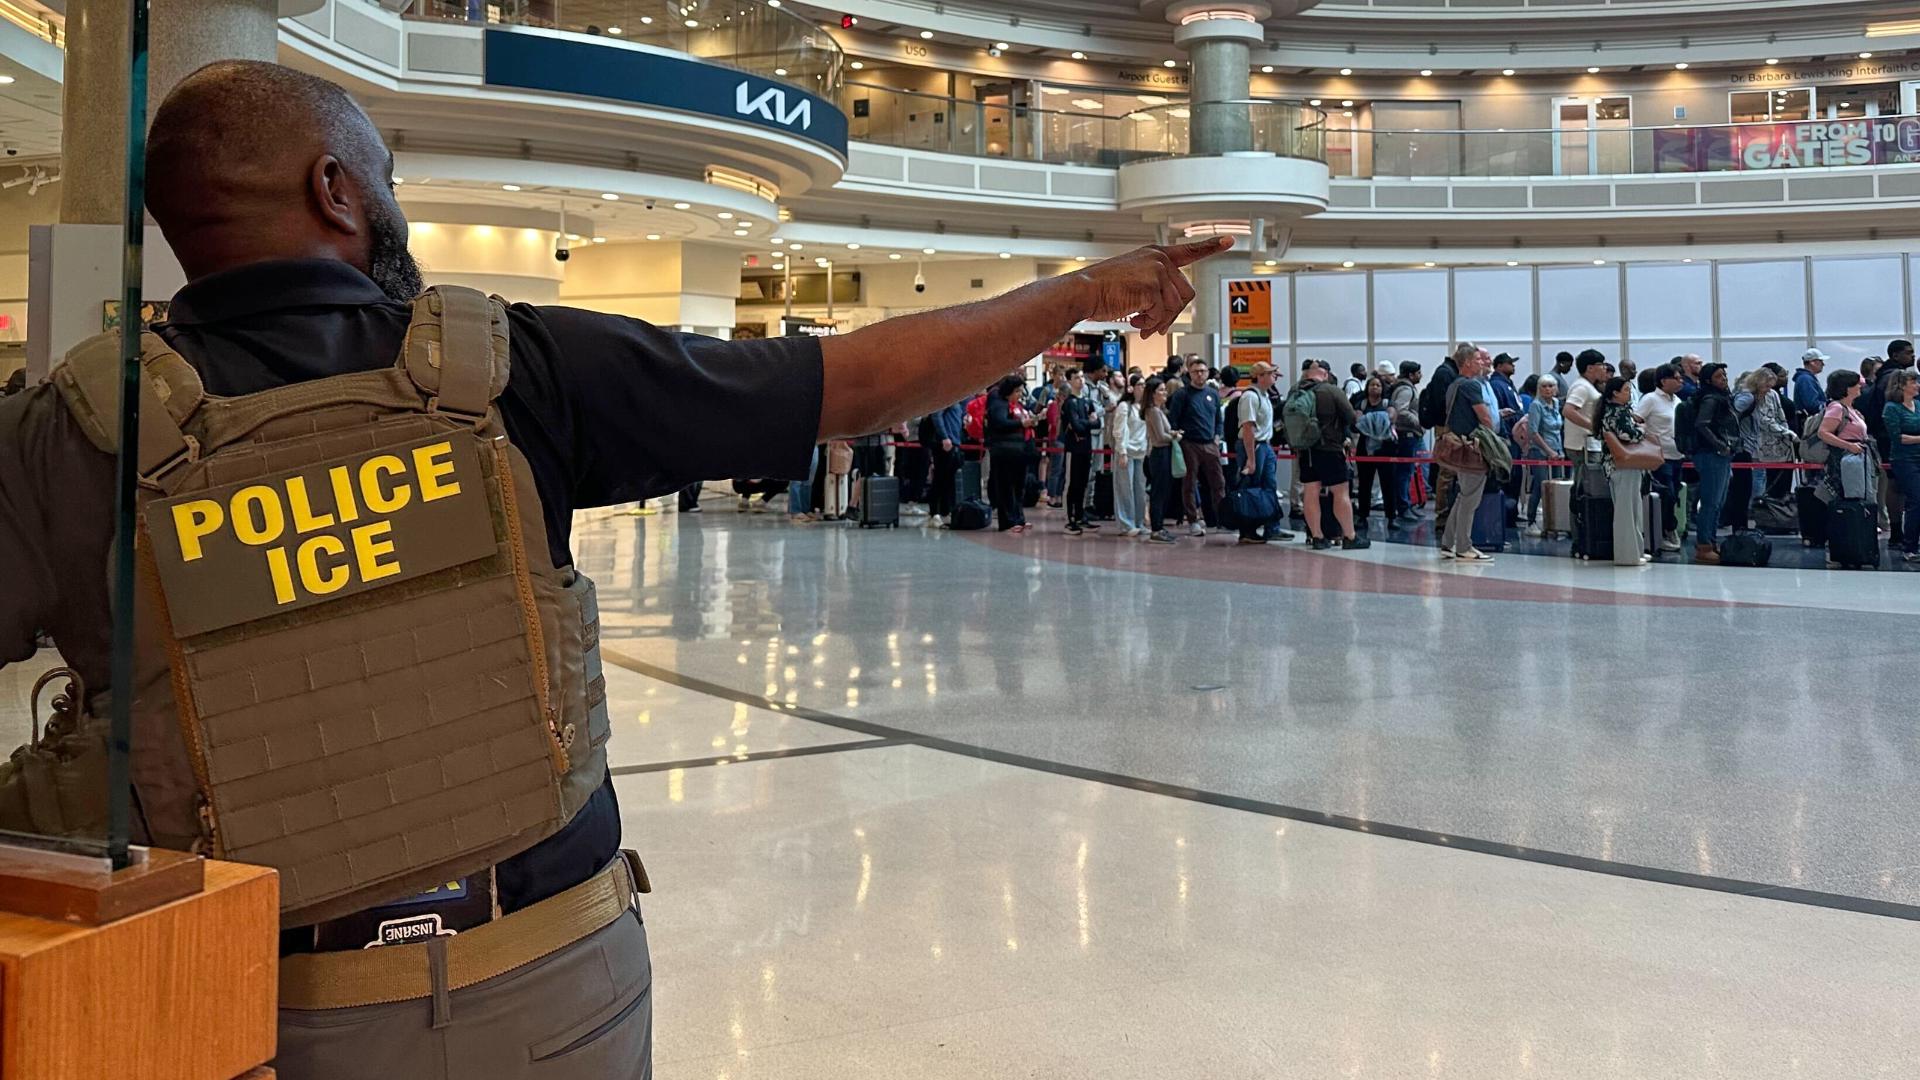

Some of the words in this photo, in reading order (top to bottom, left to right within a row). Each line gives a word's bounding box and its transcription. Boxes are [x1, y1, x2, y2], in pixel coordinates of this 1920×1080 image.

[904, 45, 927, 57] USO
[1118, 71, 1150, 83] Airport
[1152, 73, 1179, 85] Guest
[1730, 74, 1745, 83] Dr.
[1748, 72, 1791, 82] Barbara
[1794, 70, 1825, 80] Lewis
[1828, 67, 1853, 78] King
[1856, 63, 1907, 75] Interfaith
[736, 80, 811, 131] KIA
[1795, 122, 1867, 141] FROM
[1873, 122, 1896, 143] TO
[1744, 139, 1871, 169] GATES
[171, 441, 462, 562] POLICE
[266, 520, 401, 605] ICE
[385, 921, 434, 941] INSANE
